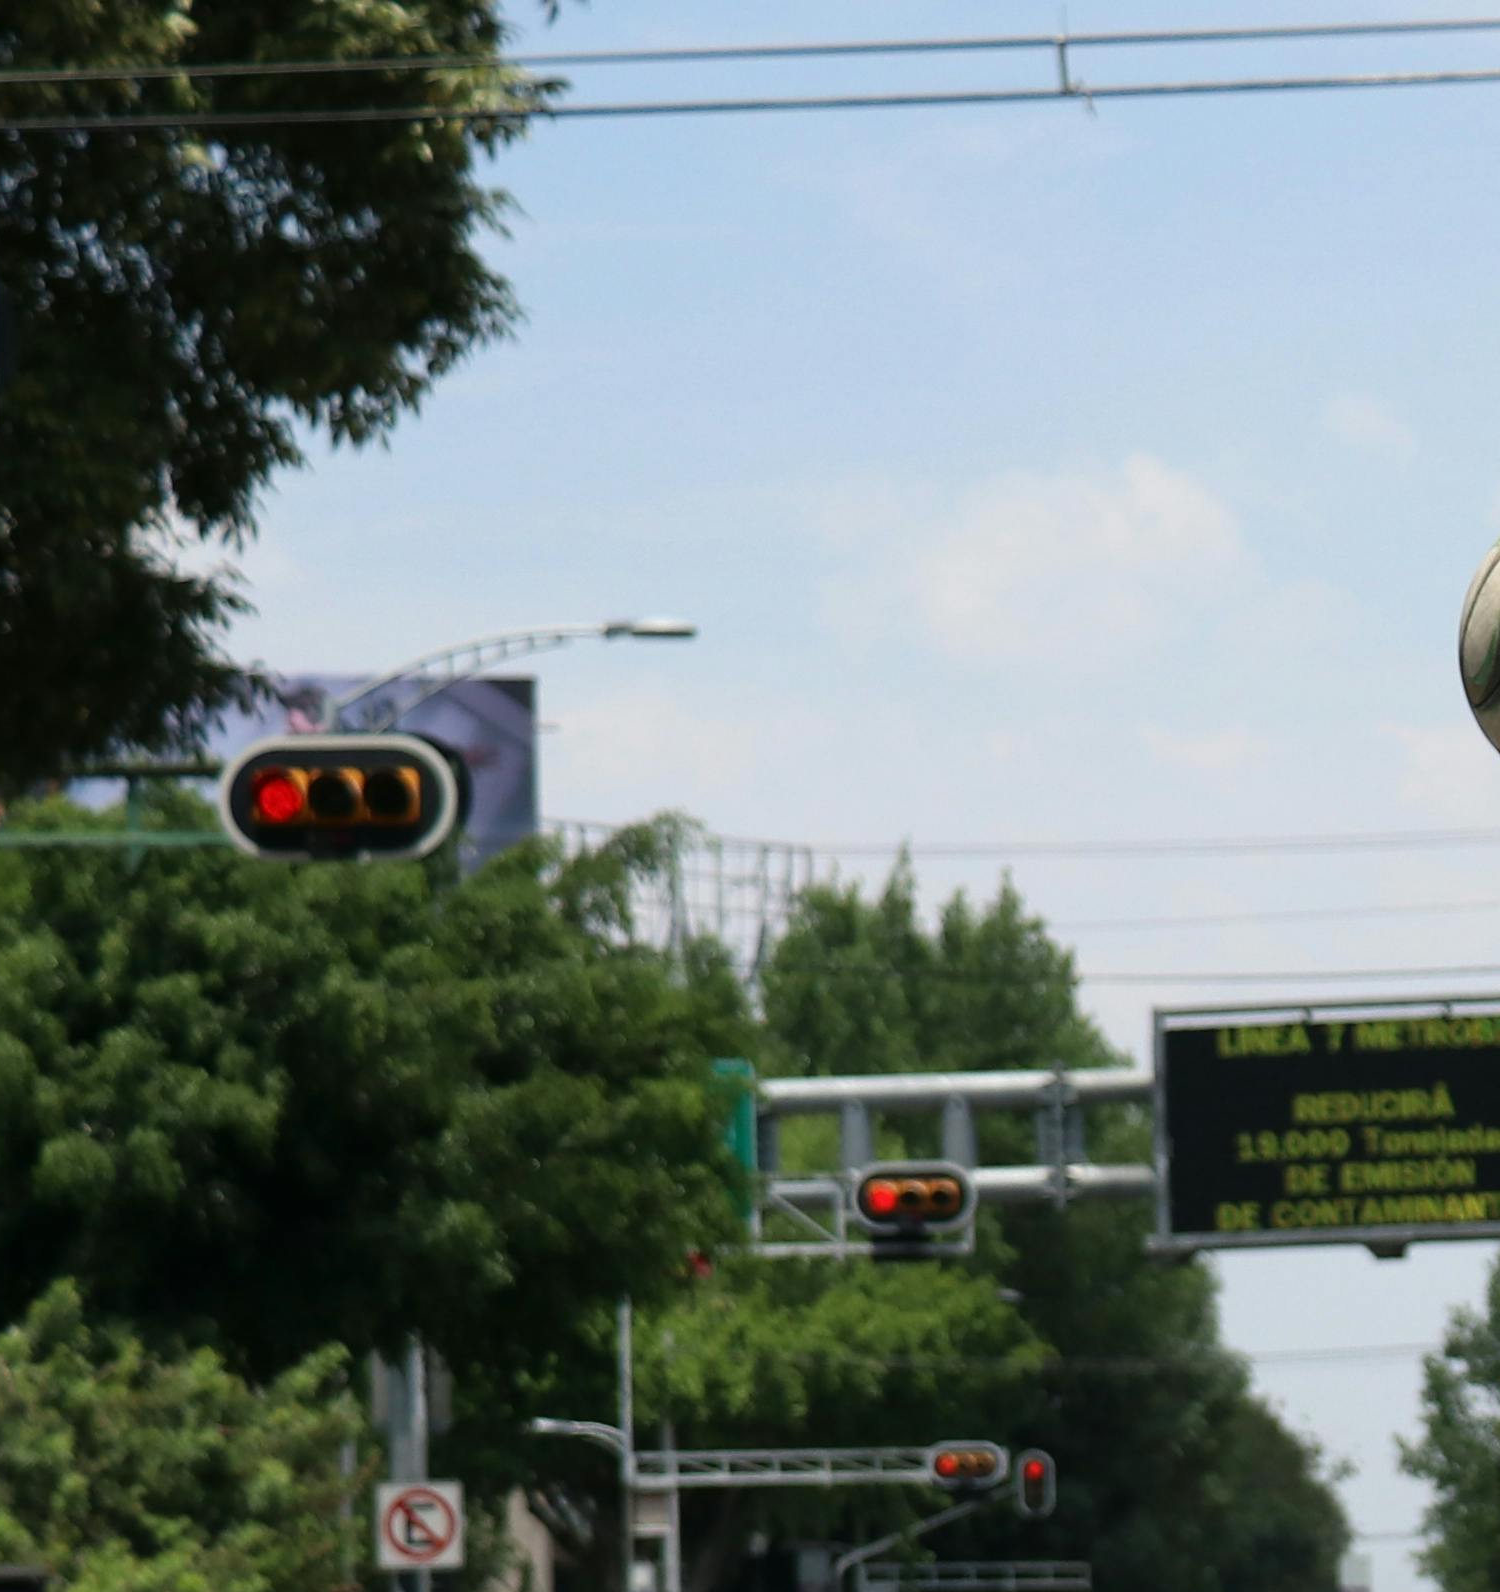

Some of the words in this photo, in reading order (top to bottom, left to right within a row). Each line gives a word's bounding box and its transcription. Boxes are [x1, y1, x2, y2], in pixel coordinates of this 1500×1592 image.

[1292, 1081, 1456, 1123] REDUCIRÁ
[1283, 1163, 1331, 1196] DE
[1340, 1155, 1477, 1193] EMISIÓN
[1215, 1202, 1261, 1231] DE
